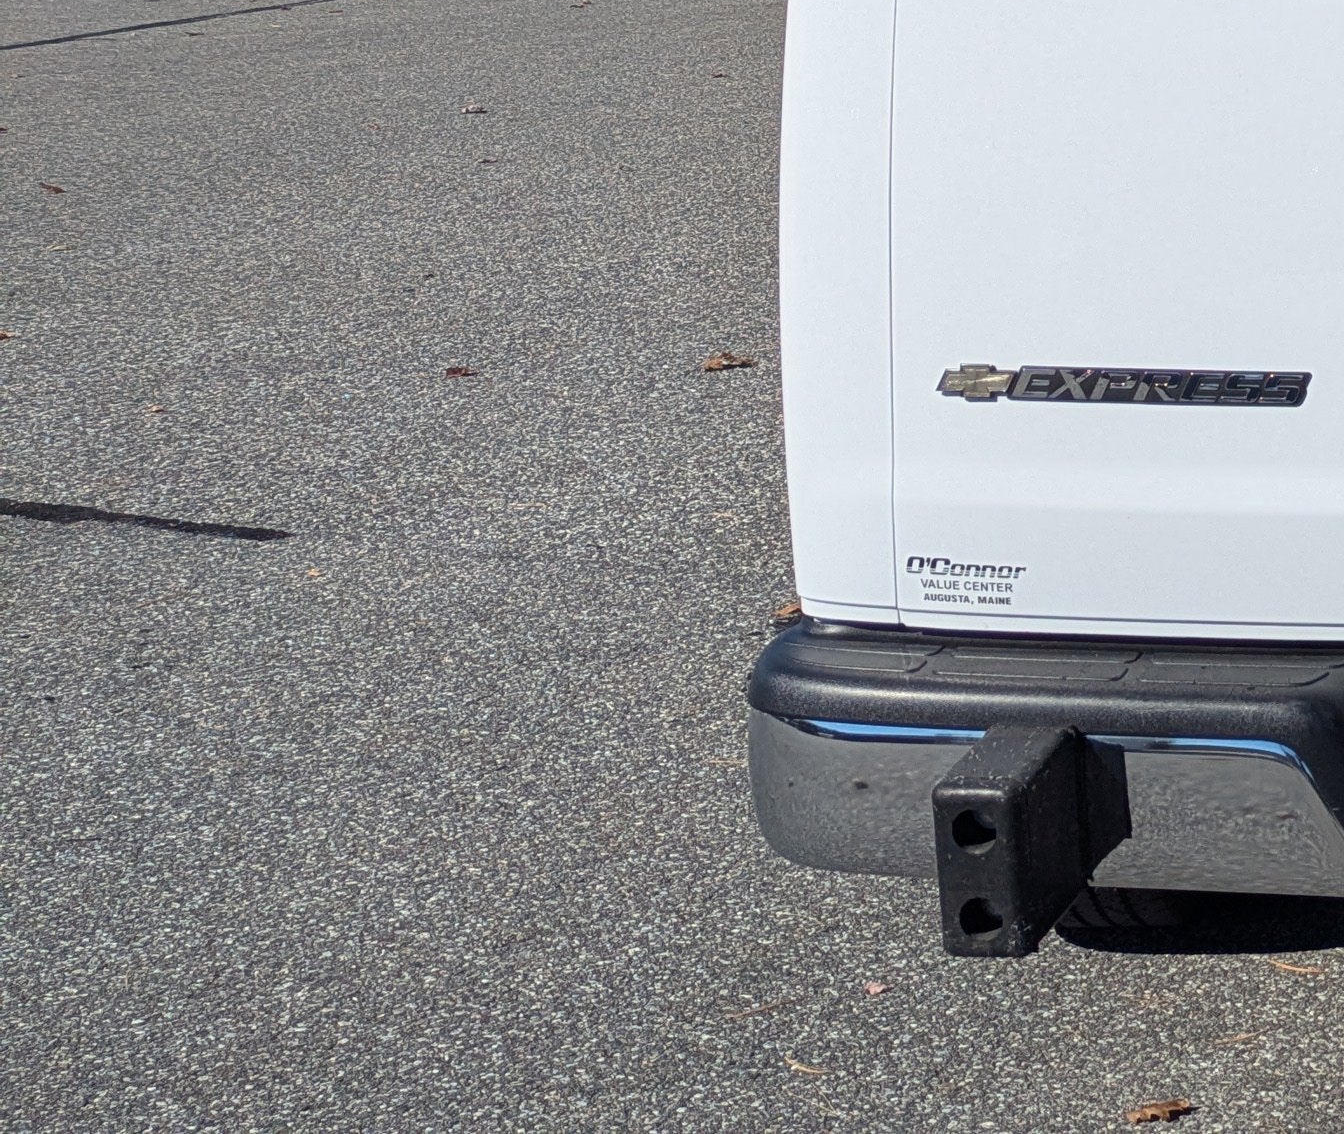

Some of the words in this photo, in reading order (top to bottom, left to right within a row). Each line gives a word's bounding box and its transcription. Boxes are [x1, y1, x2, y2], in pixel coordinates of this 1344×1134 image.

[1013, 368, 1309, 405] EXPRESS
[906, 556, 1026, 579] O'Connor
[920, 579, 960, 591] VALUE
[963, 581, 1014, 593] CENTER
[924, 593, 974, 605] AUGUSTA,
[978, 596, 1012, 605] MAINE
